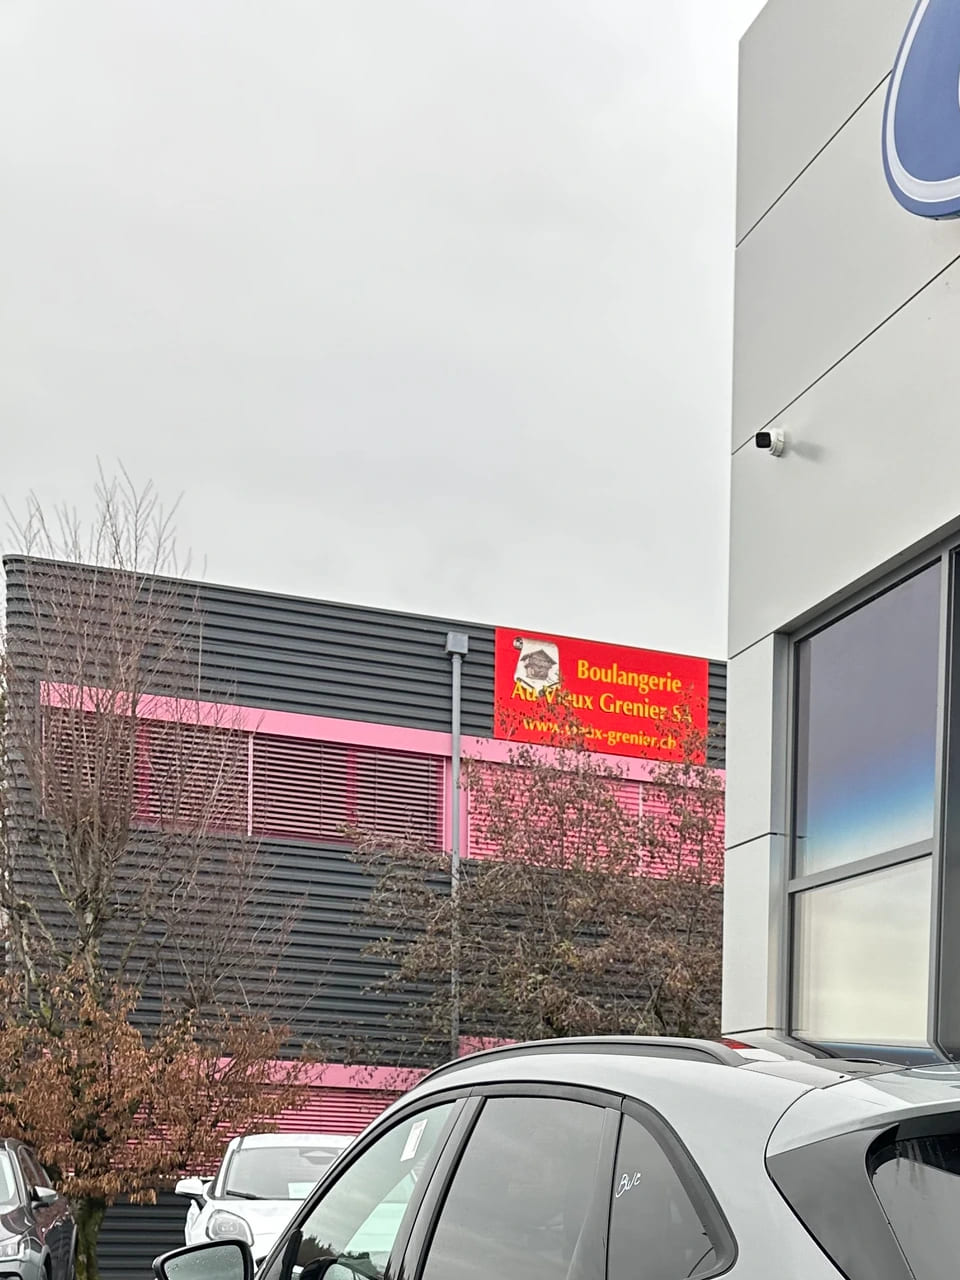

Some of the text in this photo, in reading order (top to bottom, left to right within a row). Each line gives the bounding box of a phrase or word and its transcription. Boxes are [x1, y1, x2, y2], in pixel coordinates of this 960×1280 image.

[577, 659, 682, 694] Boulangerie
[511, 681, 537, 701] Au
[542, 685, 593, 710] Veux
[599, 693, 667, 720] Grenier
